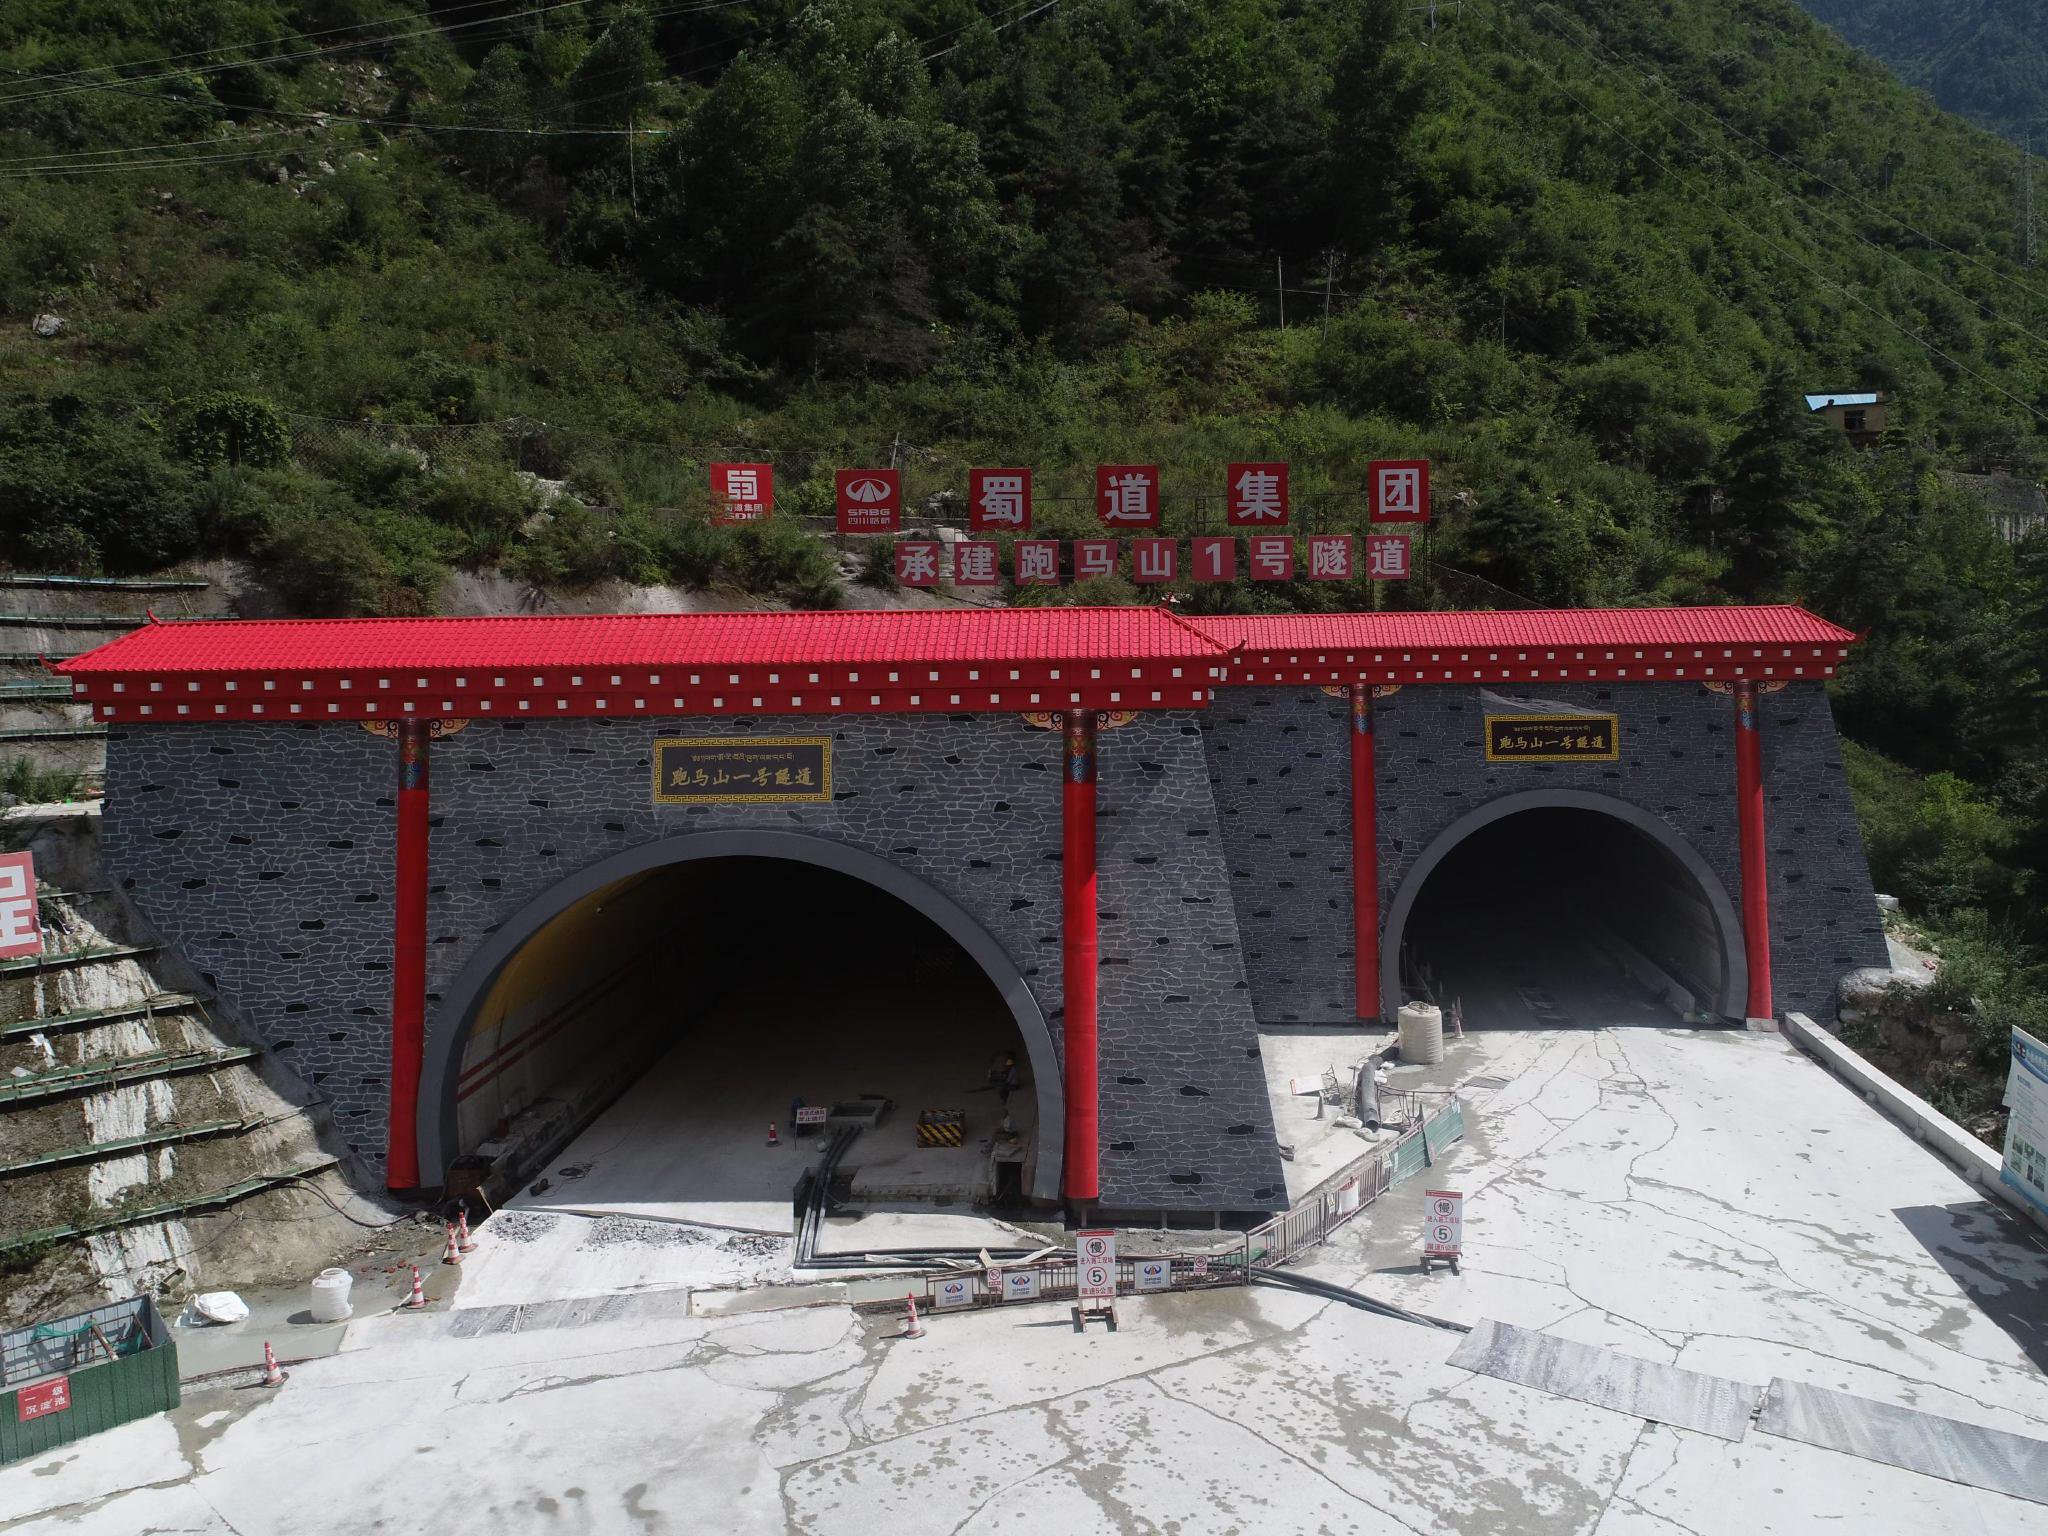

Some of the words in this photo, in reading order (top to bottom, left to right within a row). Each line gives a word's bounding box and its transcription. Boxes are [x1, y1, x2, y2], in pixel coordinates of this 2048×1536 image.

[979, 468, 1420, 524] 蜀道集团
[900, 539, 1405, 582] 承建跑马山1号隧道
[1498, 735, 1606, 750] 跑马山一号隧道
[669, 766, 815, 787] 跑马山一号隧道
[1438, 1228, 1448, 1241] 5
[1090, 1241, 1102, 1253] 慢
[1092, 1269, 1102, 1283] 5
[25, 1396, 66, 1415] 沉淀池
